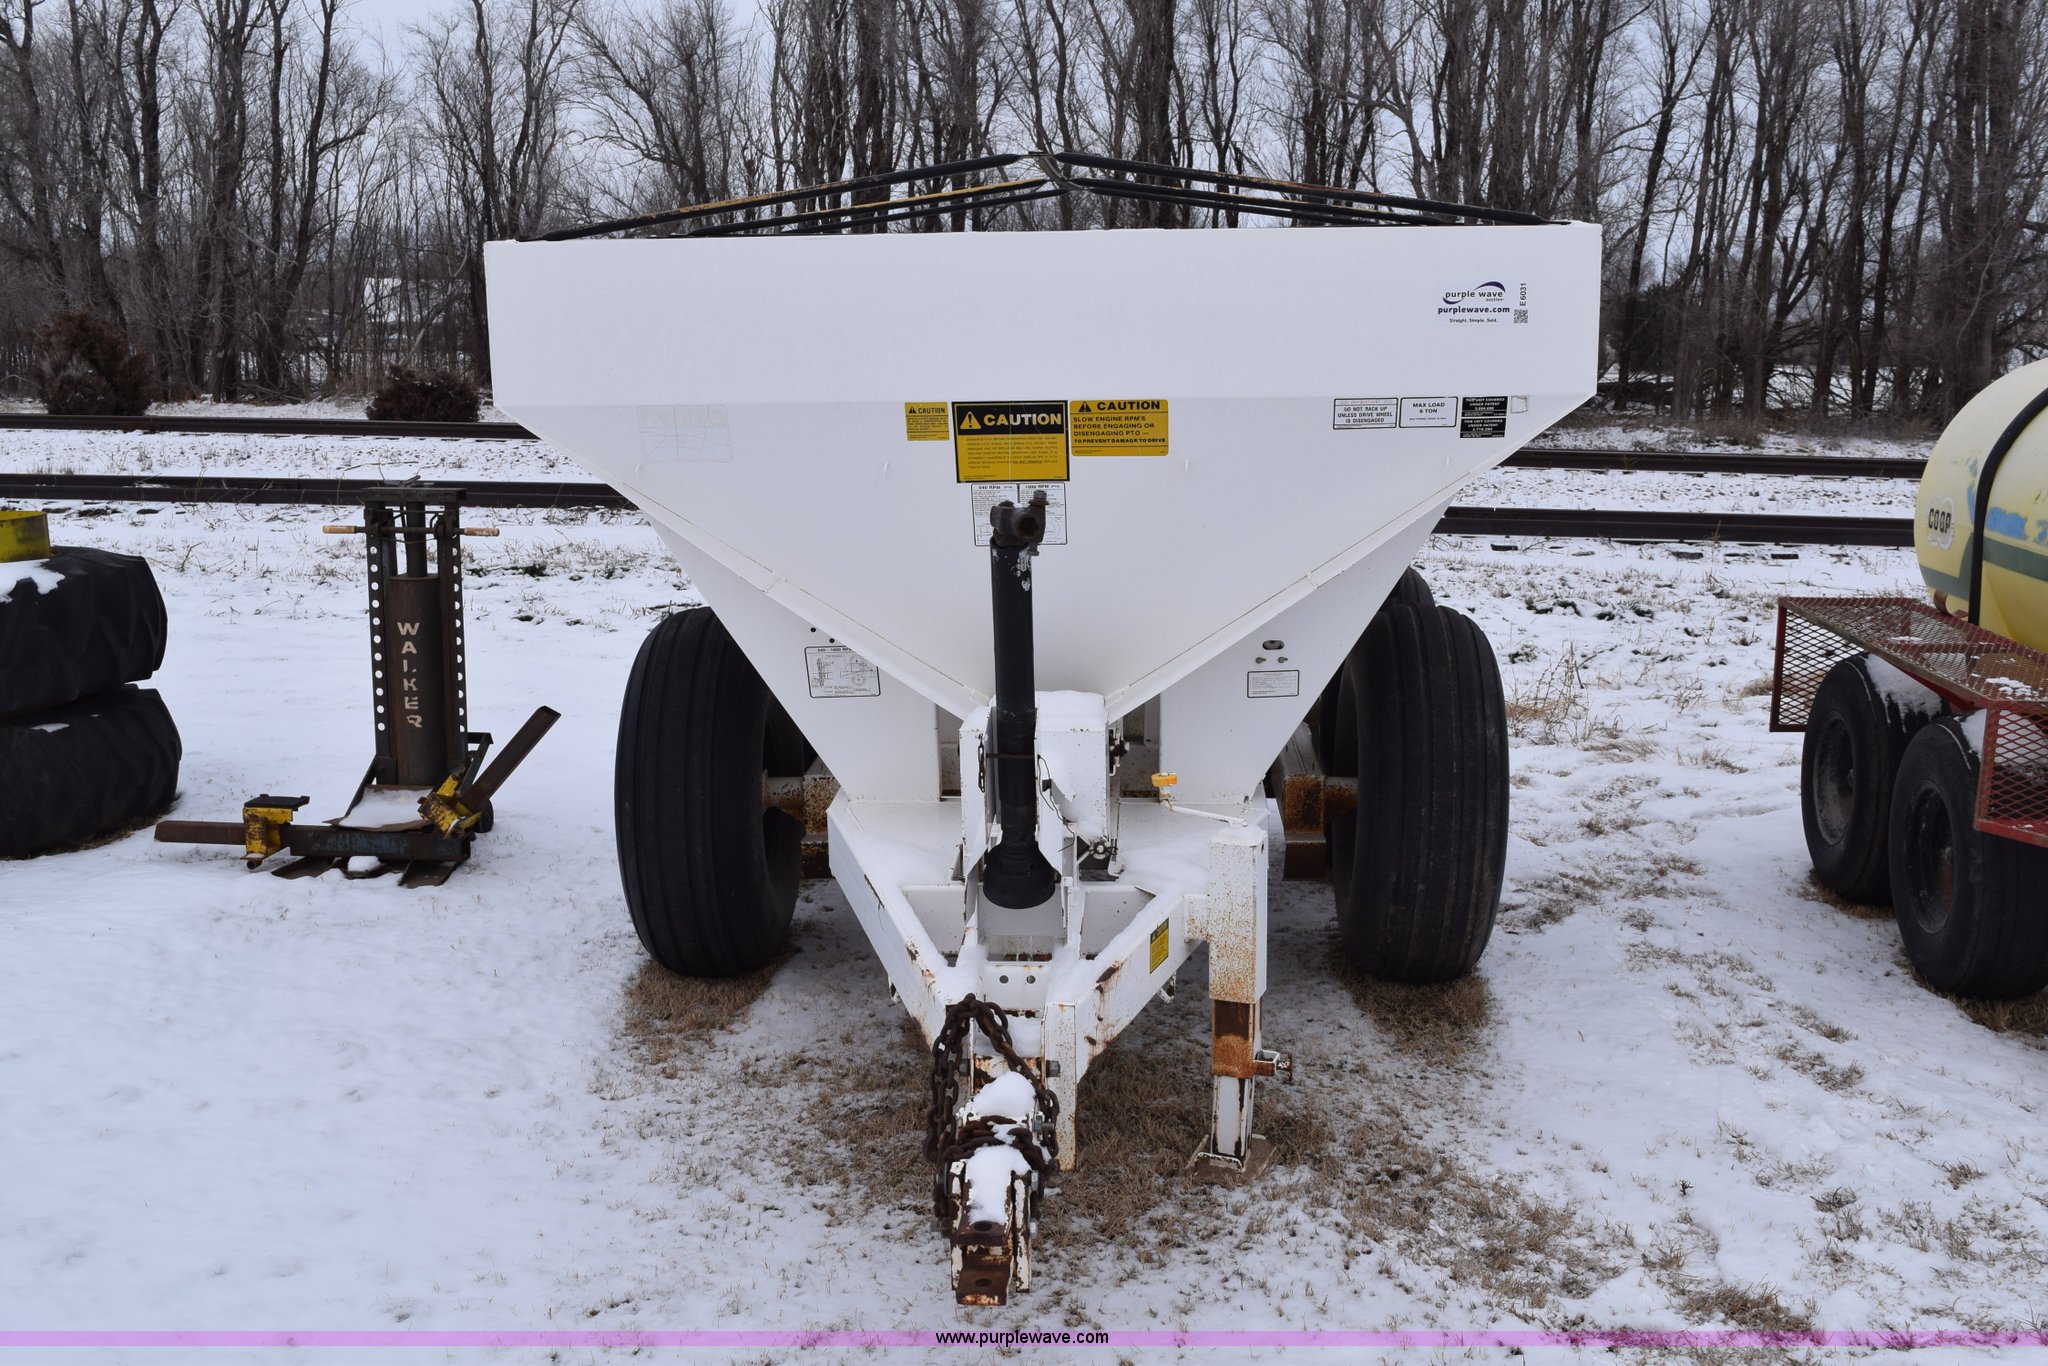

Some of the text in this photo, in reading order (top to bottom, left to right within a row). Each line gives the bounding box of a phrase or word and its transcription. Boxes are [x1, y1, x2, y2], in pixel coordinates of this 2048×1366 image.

[1445, 290, 1476, 299] purple
[1519, 282, 1527, 300] 6031
[1438, 306, 1510, 315] purplewave.com
[1096, 401, 1160, 411] CAUTION
[983, 413, 1062, 426] CAUTION
[397, 622, 423, 728] WALKER
